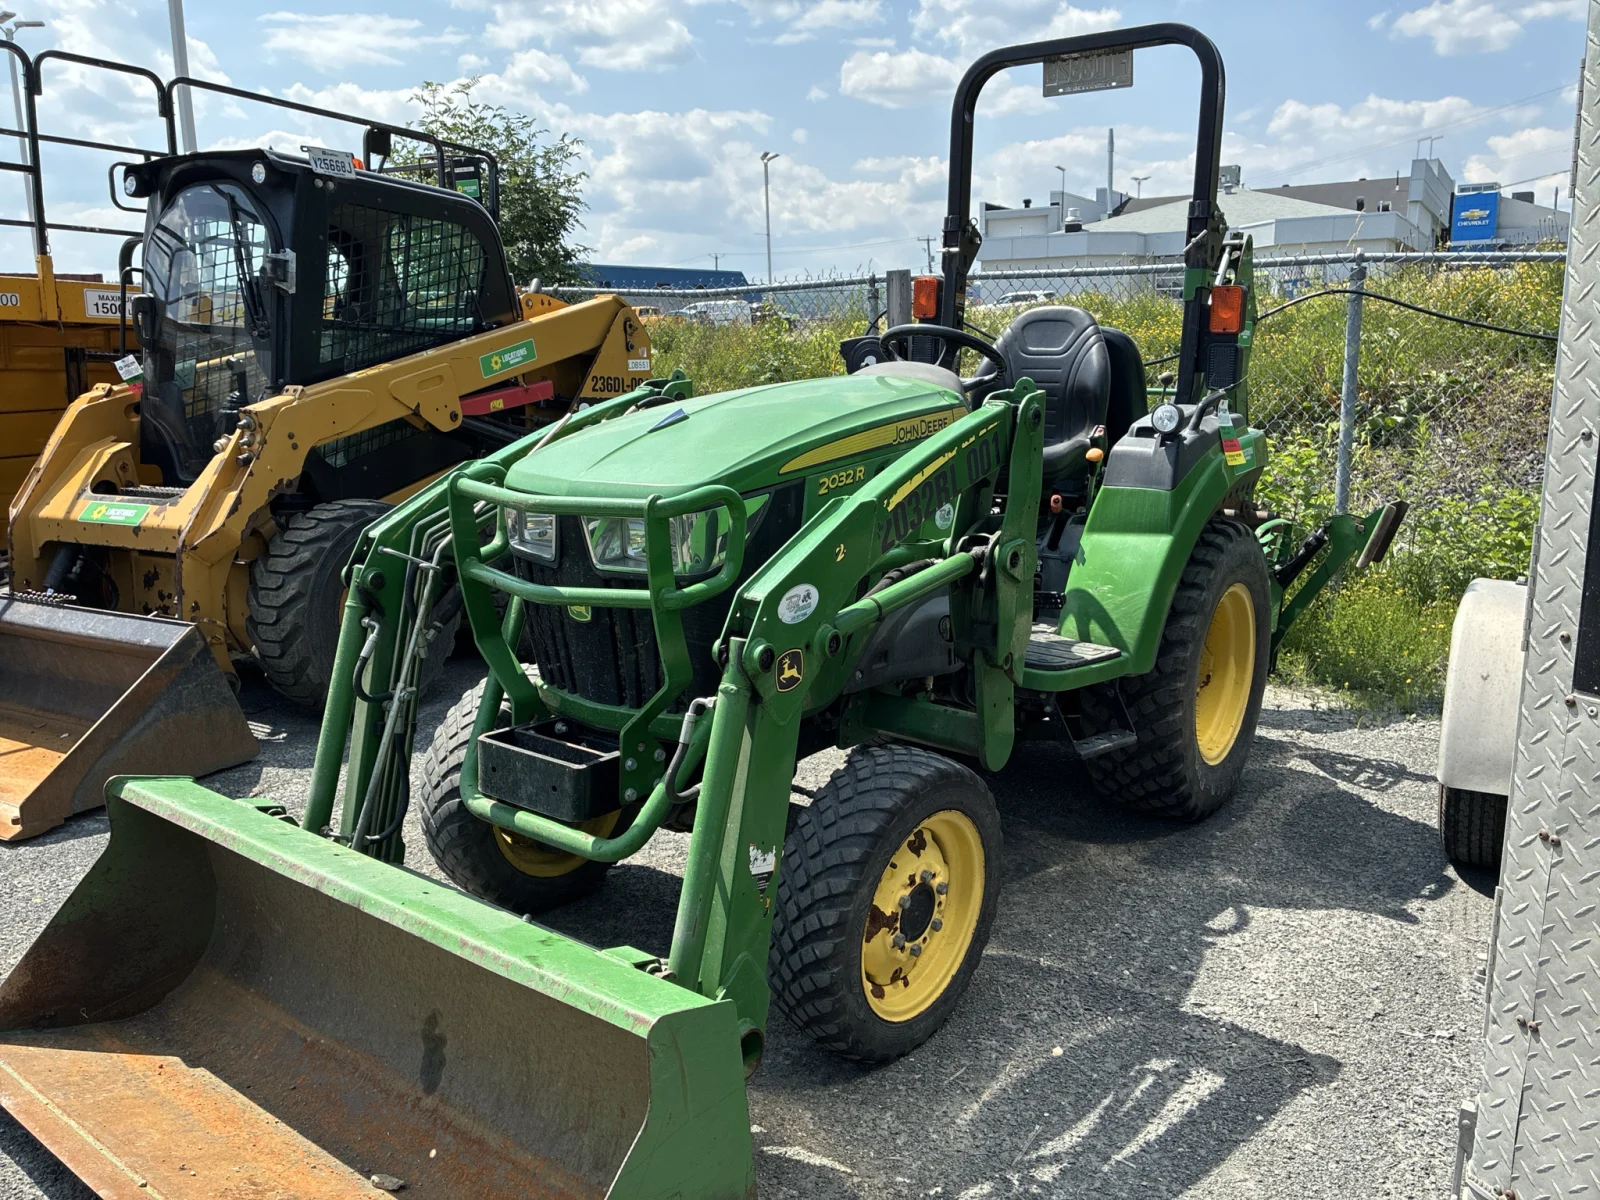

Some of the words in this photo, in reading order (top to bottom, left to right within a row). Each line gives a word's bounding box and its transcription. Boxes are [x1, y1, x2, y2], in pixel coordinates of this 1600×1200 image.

[892, 425, 919, 443] JOHN
[920, 417, 948, 436] DEERE
[967, 431, 1001, 483] 001
